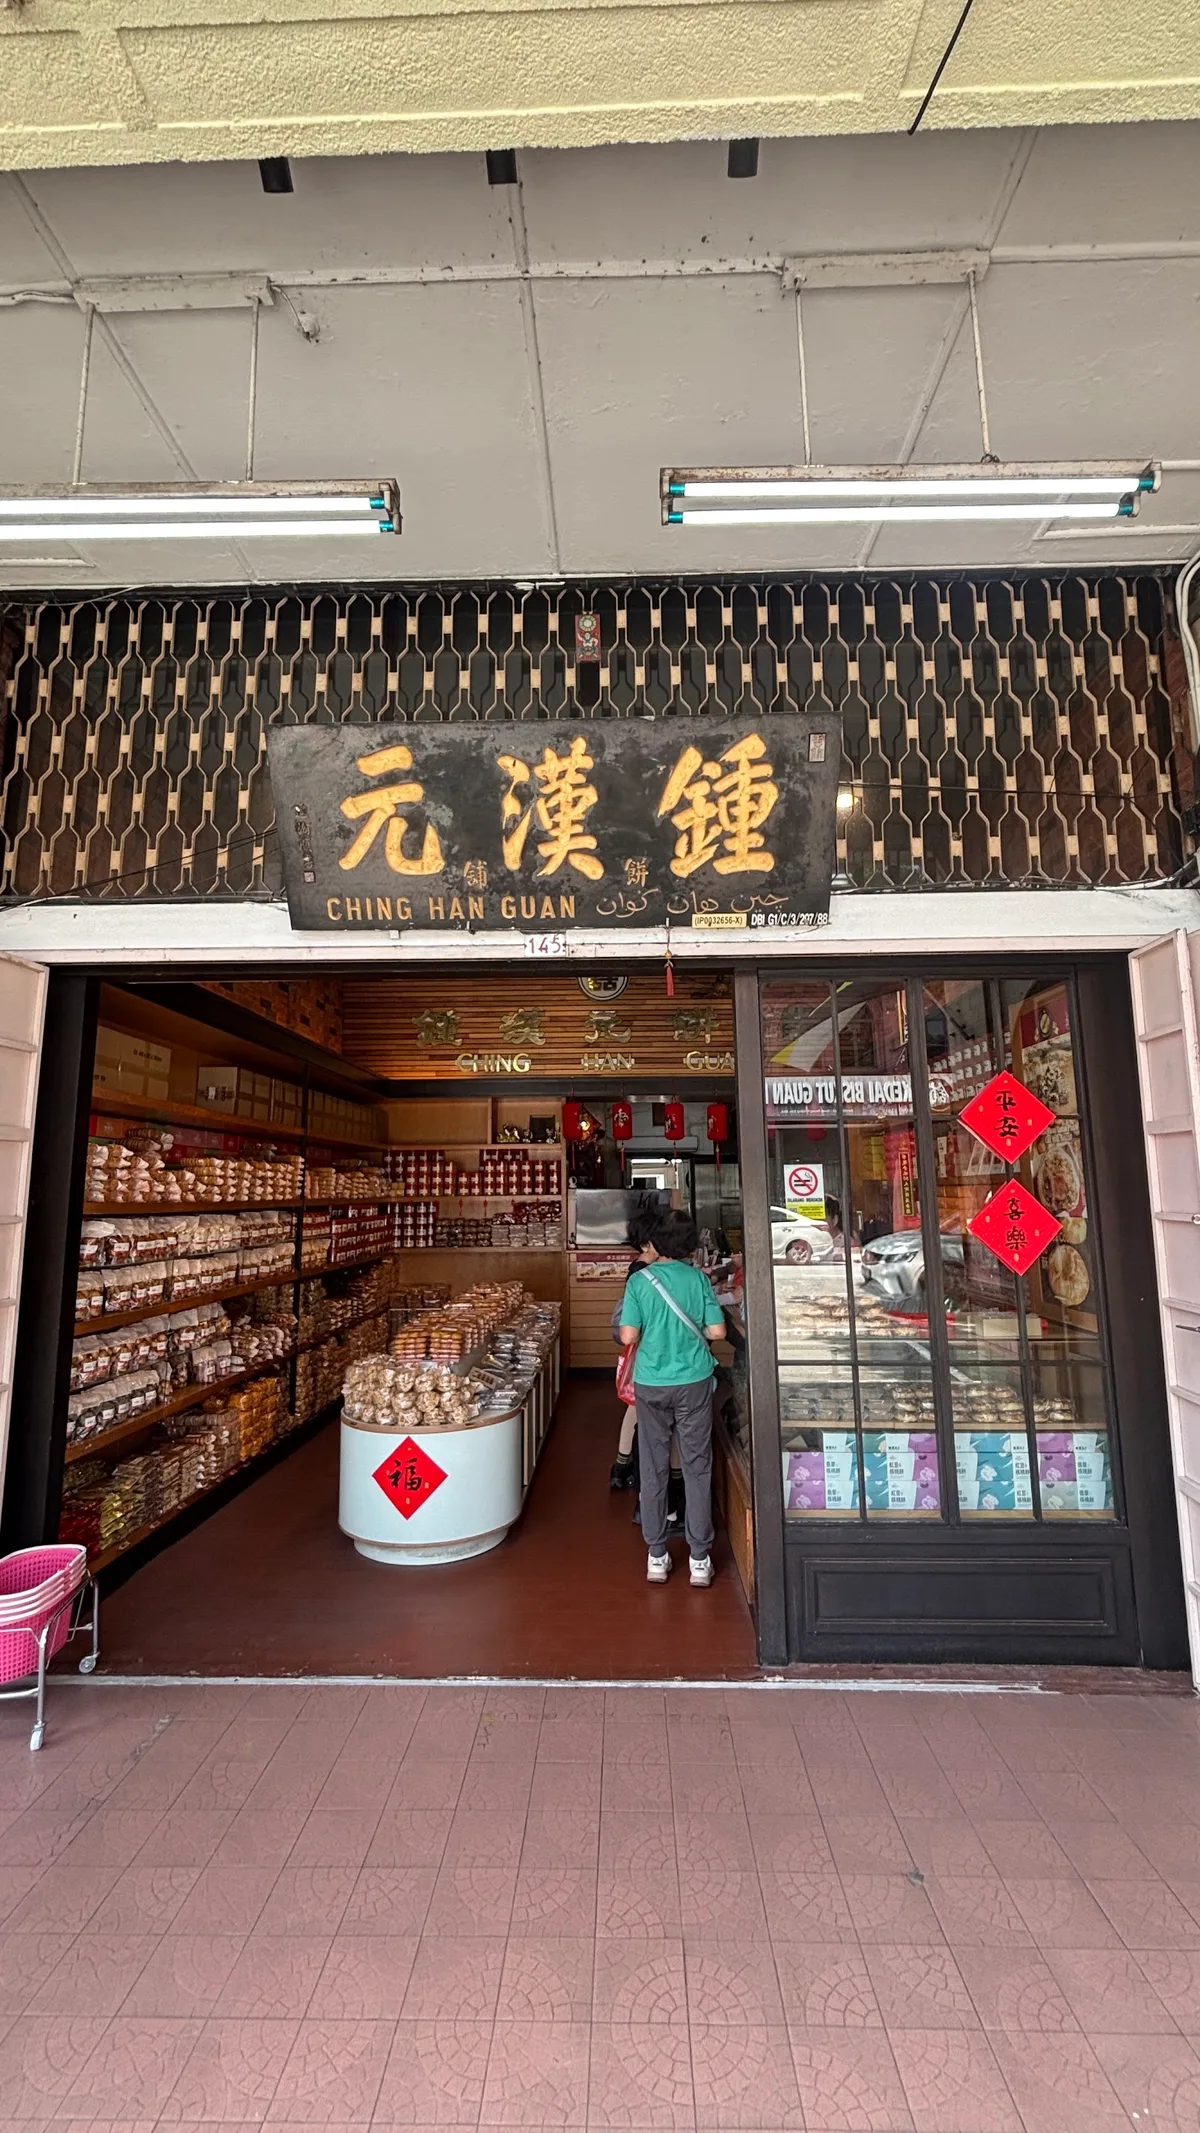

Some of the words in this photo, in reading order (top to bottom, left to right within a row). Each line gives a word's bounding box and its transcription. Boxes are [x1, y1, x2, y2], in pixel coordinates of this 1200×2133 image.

[326, 896, 413, 921] CHING
[429, 896, 485, 921] HAN
[501, 895, 576, 919] GUAN
[529, 934, 561, 954] 145
[455, 1052, 531, 1073] CHING
[583, 1051, 633, 1072] HAN
[685, 1050, 735, 1070] GUA
[993, 1090, 1020, 1137] 平安
[388, 1457, 423, 1492] 福
